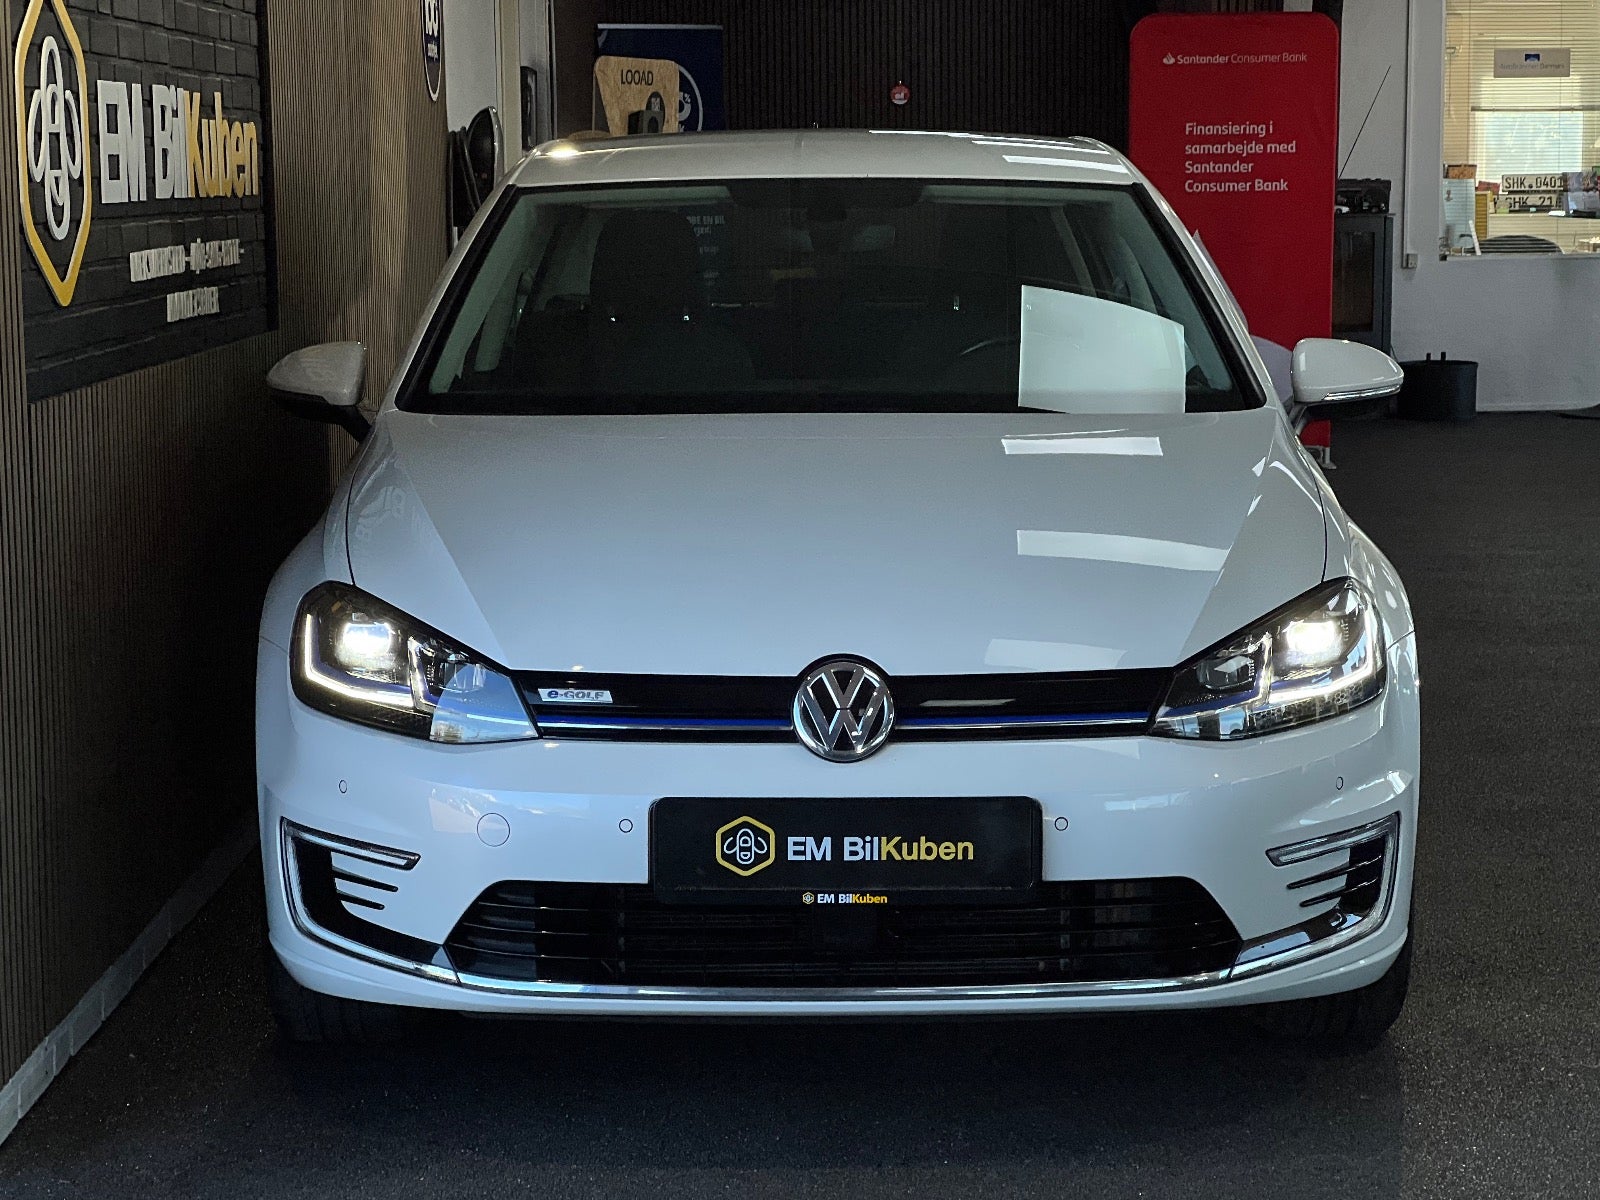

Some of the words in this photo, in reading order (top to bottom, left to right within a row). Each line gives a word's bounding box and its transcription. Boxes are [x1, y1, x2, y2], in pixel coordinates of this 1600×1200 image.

[1176, 53, 1230, 65] Santander
[1231, 53, 1281, 64] Consumer
[1282, 52, 1308, 63] Bank
[620, 69, 654, 86] LOOAD
[1185, 121, 1266, 138] Finansiering
[1269, 120, 1273, 134] i
[97, 80, 148, 204] EM
[152, 84, 259, 199] BilKuben
[1185, 140, 1264, 157] samarbejde
[1267, 140, 1296, 153] med
[1185, 160, 1254, 174] Santander
[1185, 180, 1252, 193] Consumer
[1254, 179, 1289, 192] Bank
[546, 689, 605, 699] e-GOLF
[787, 836, 832, 861] EM
[843, 835, 974, 861] BilKuben
[817, 893, 835, 904] EM
[838, 893, 888, 904] BilKuben
